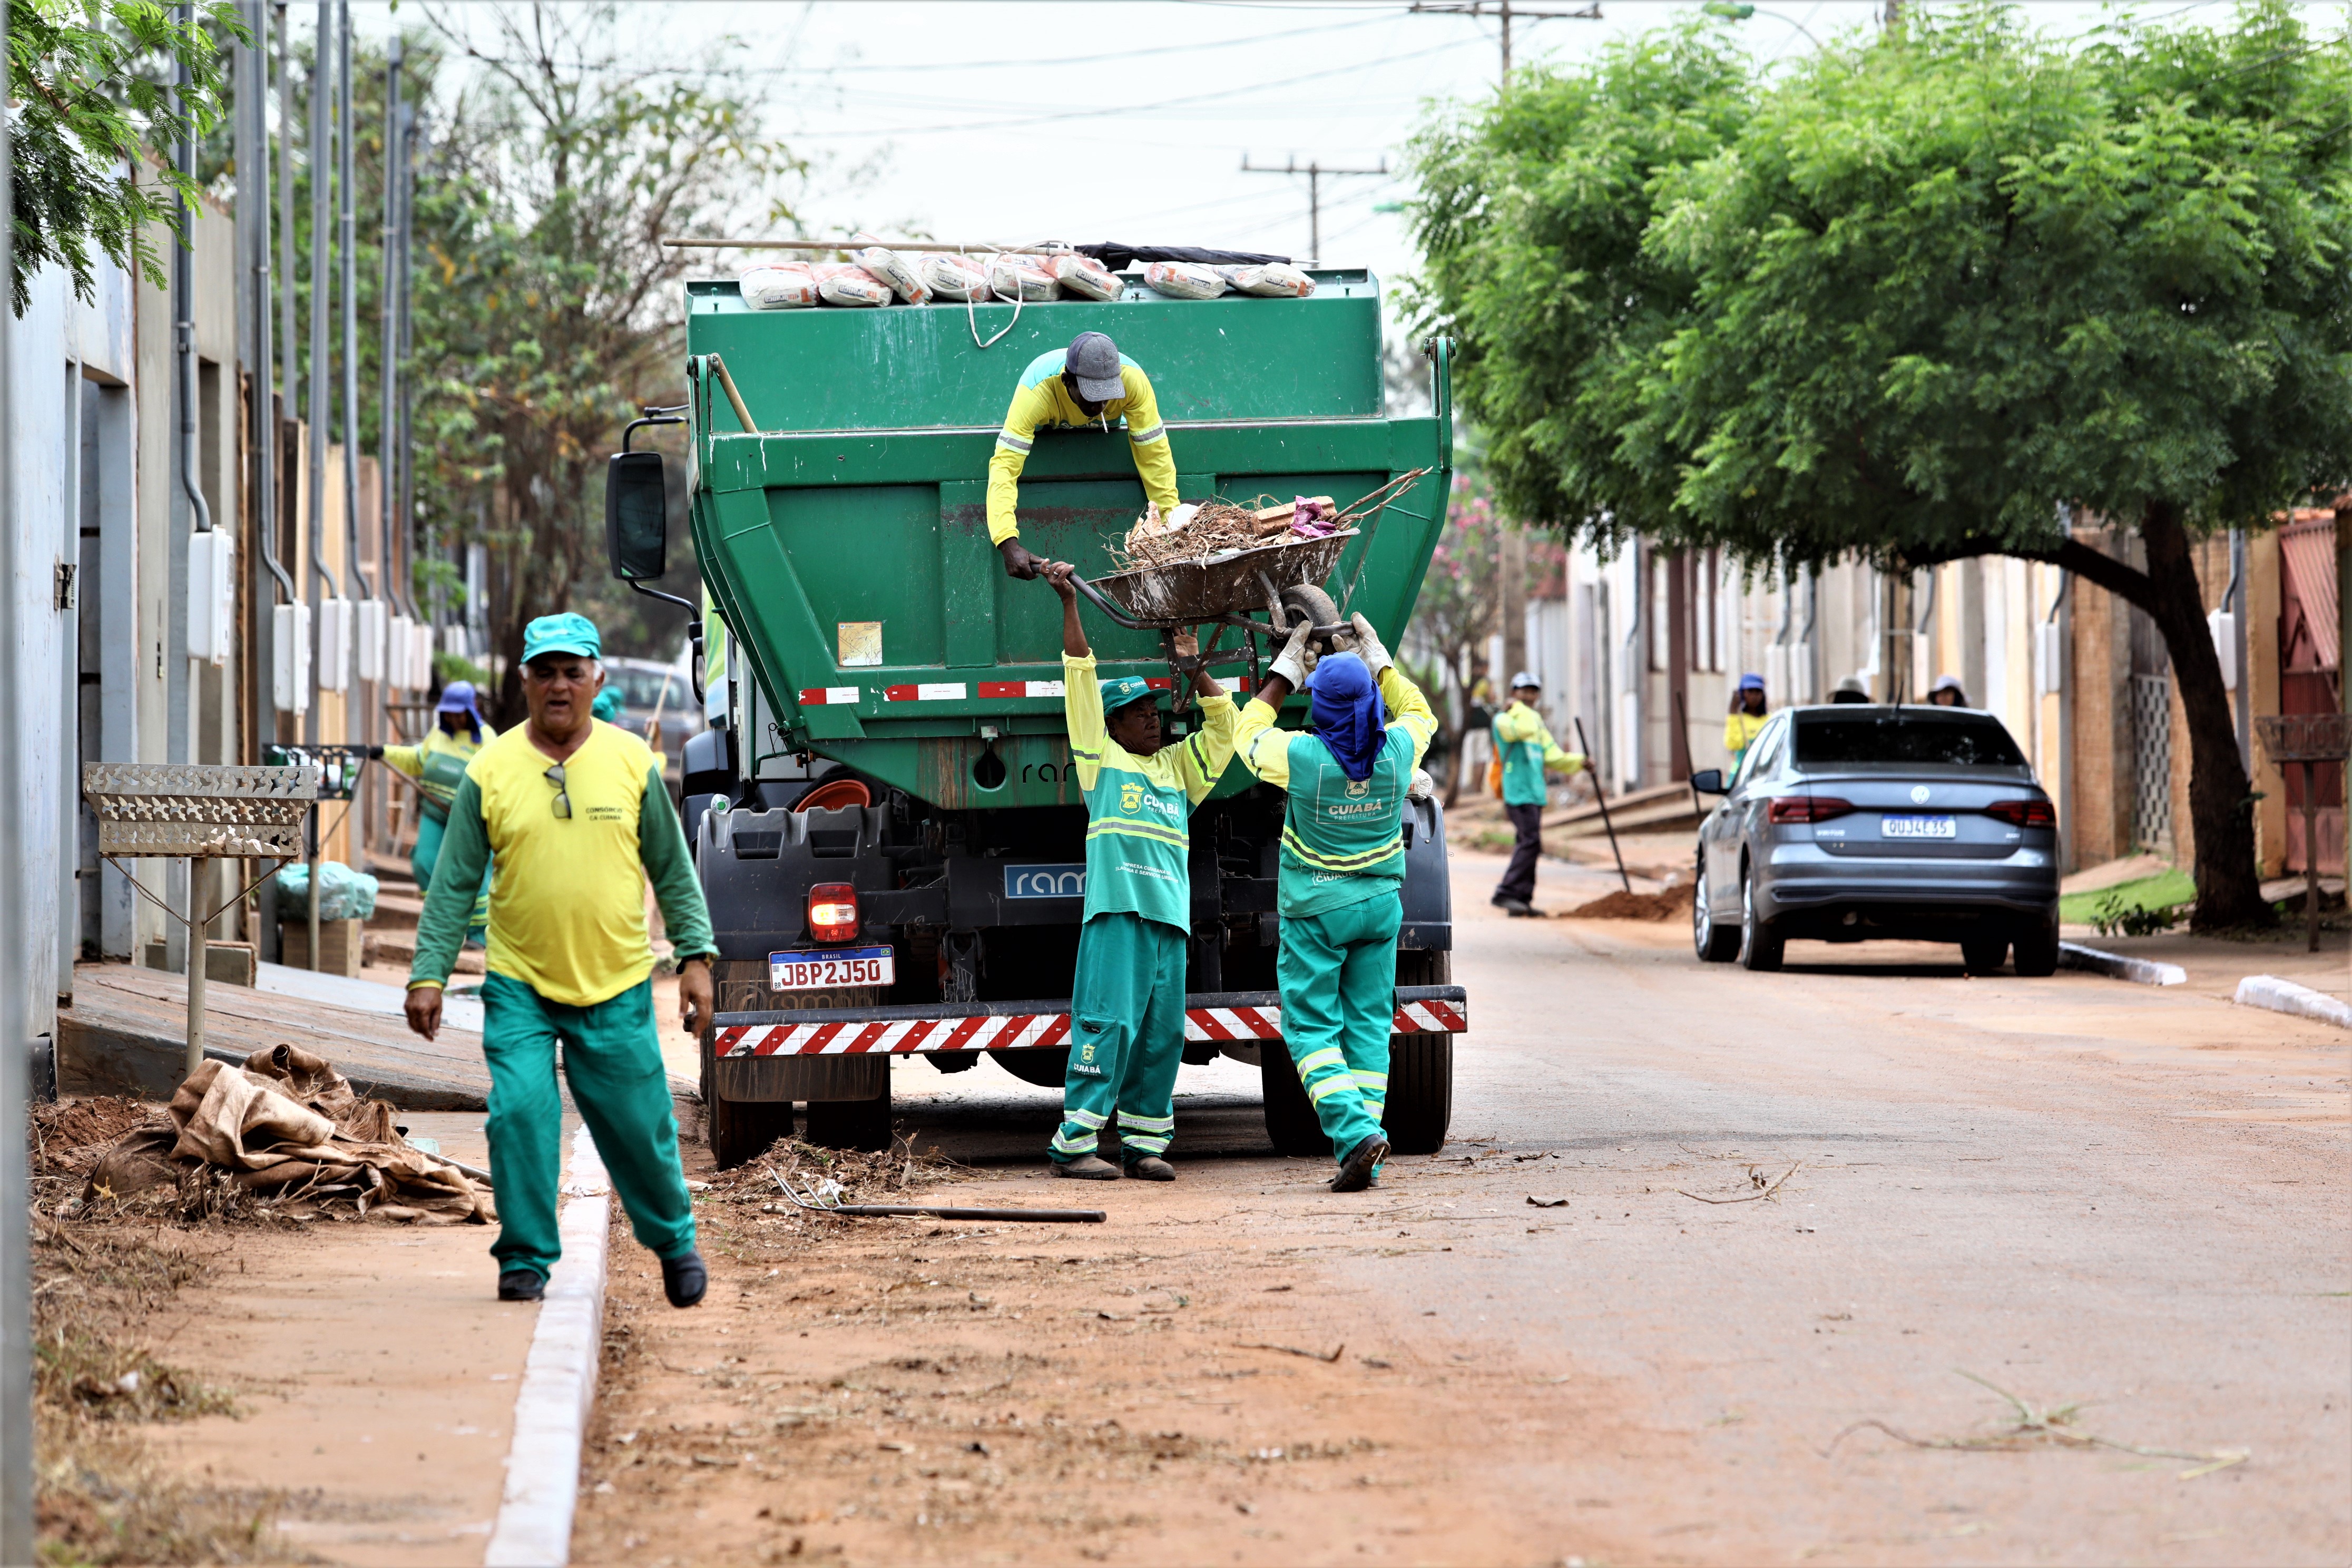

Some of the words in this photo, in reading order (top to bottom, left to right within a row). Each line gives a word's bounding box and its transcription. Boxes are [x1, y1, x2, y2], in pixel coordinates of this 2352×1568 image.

[938, 273, 965, 288] abranca
[1007, 279, 1045, 293] itaranca
[1076, 269, 1112, 291] itabranca
[1178, 274, 1210, 289] itabranca
[838, 285, 878, 299] itabranca
[1328, 798, 1383, 815] CUIABÁ
[1334, 811, 1377, 821] PREFEITURA
[781, 959, 880, 986] JBP2J50
[1074, 1063, 1101, 1074] CUIABÁ
